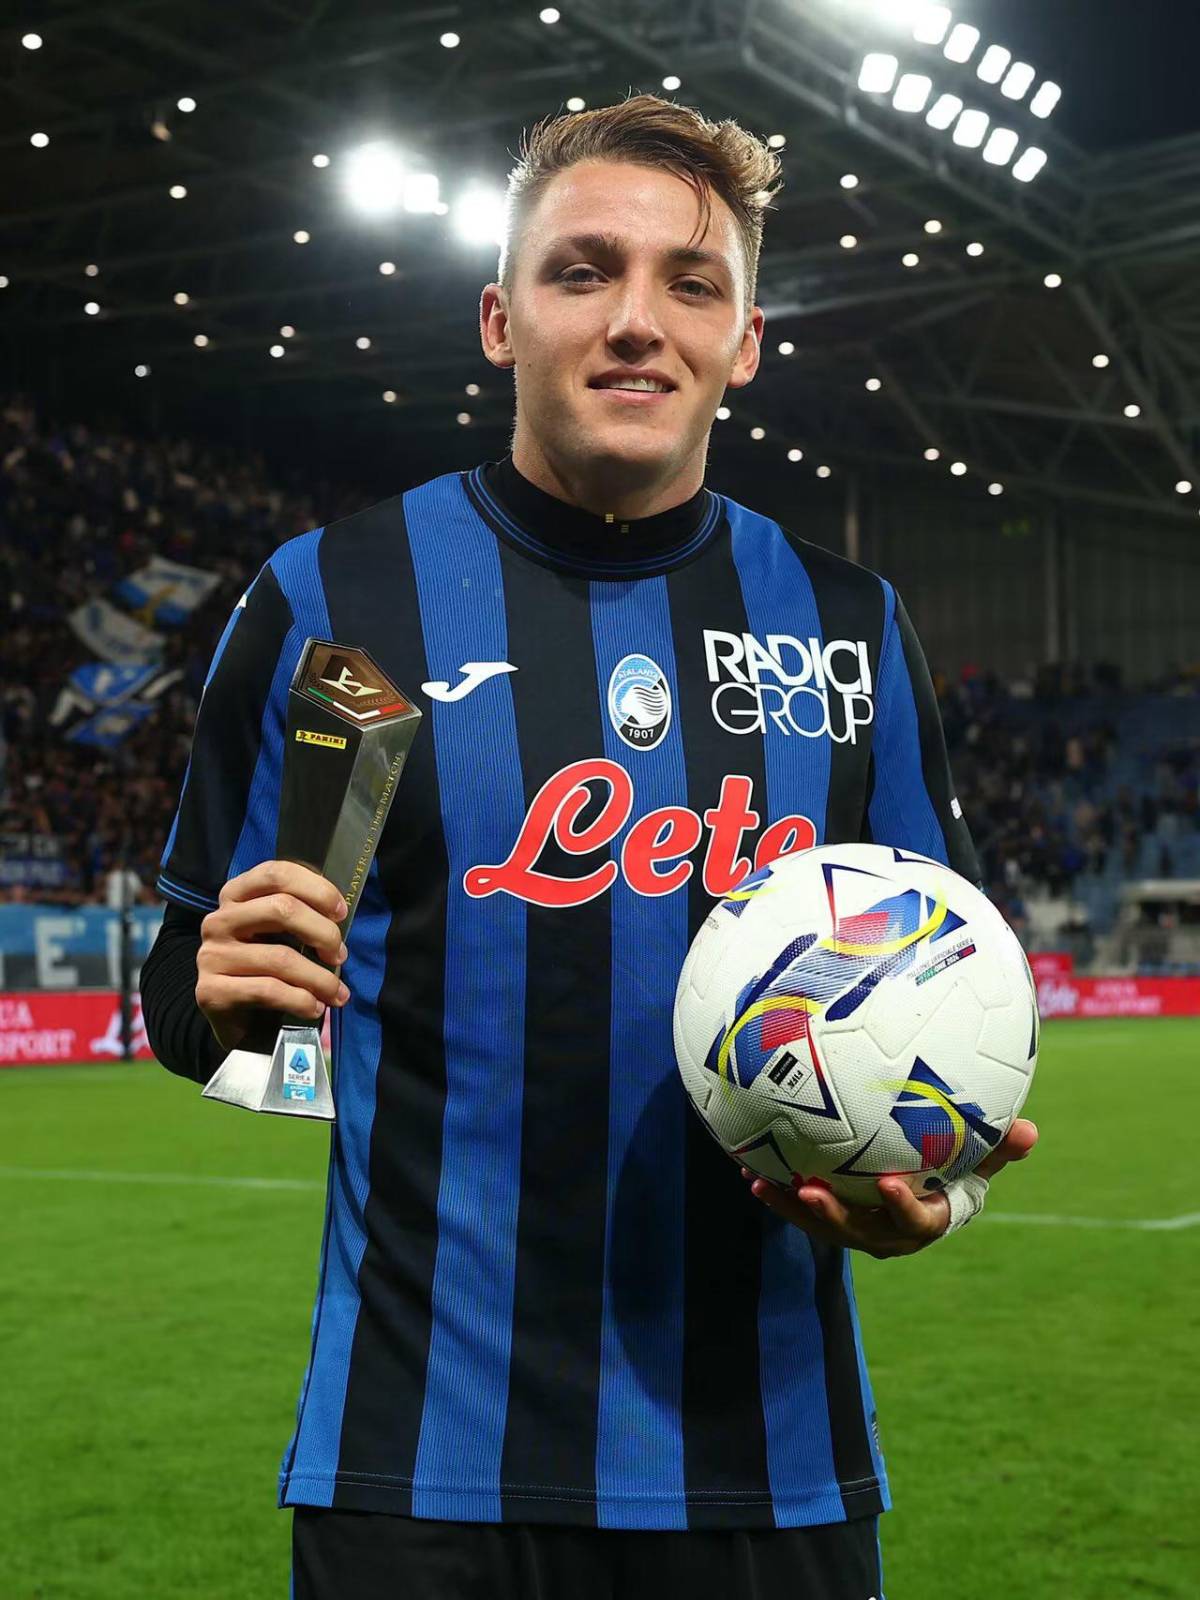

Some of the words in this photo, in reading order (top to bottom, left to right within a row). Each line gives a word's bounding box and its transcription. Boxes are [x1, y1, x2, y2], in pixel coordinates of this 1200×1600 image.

[702, 629, 873, 695] RADICI
[711, 682, 874, 745] GROUP
[310, 733, 344, 745] PANINI
[627, 728, 655, 739] 1907
[345, 855, 368, 906] PLAYER
[380, 755, 402, 805] MATCH
[287, 1073, 305, 1081] SERIE
[787, 1069, 804, 1090] FIFA
